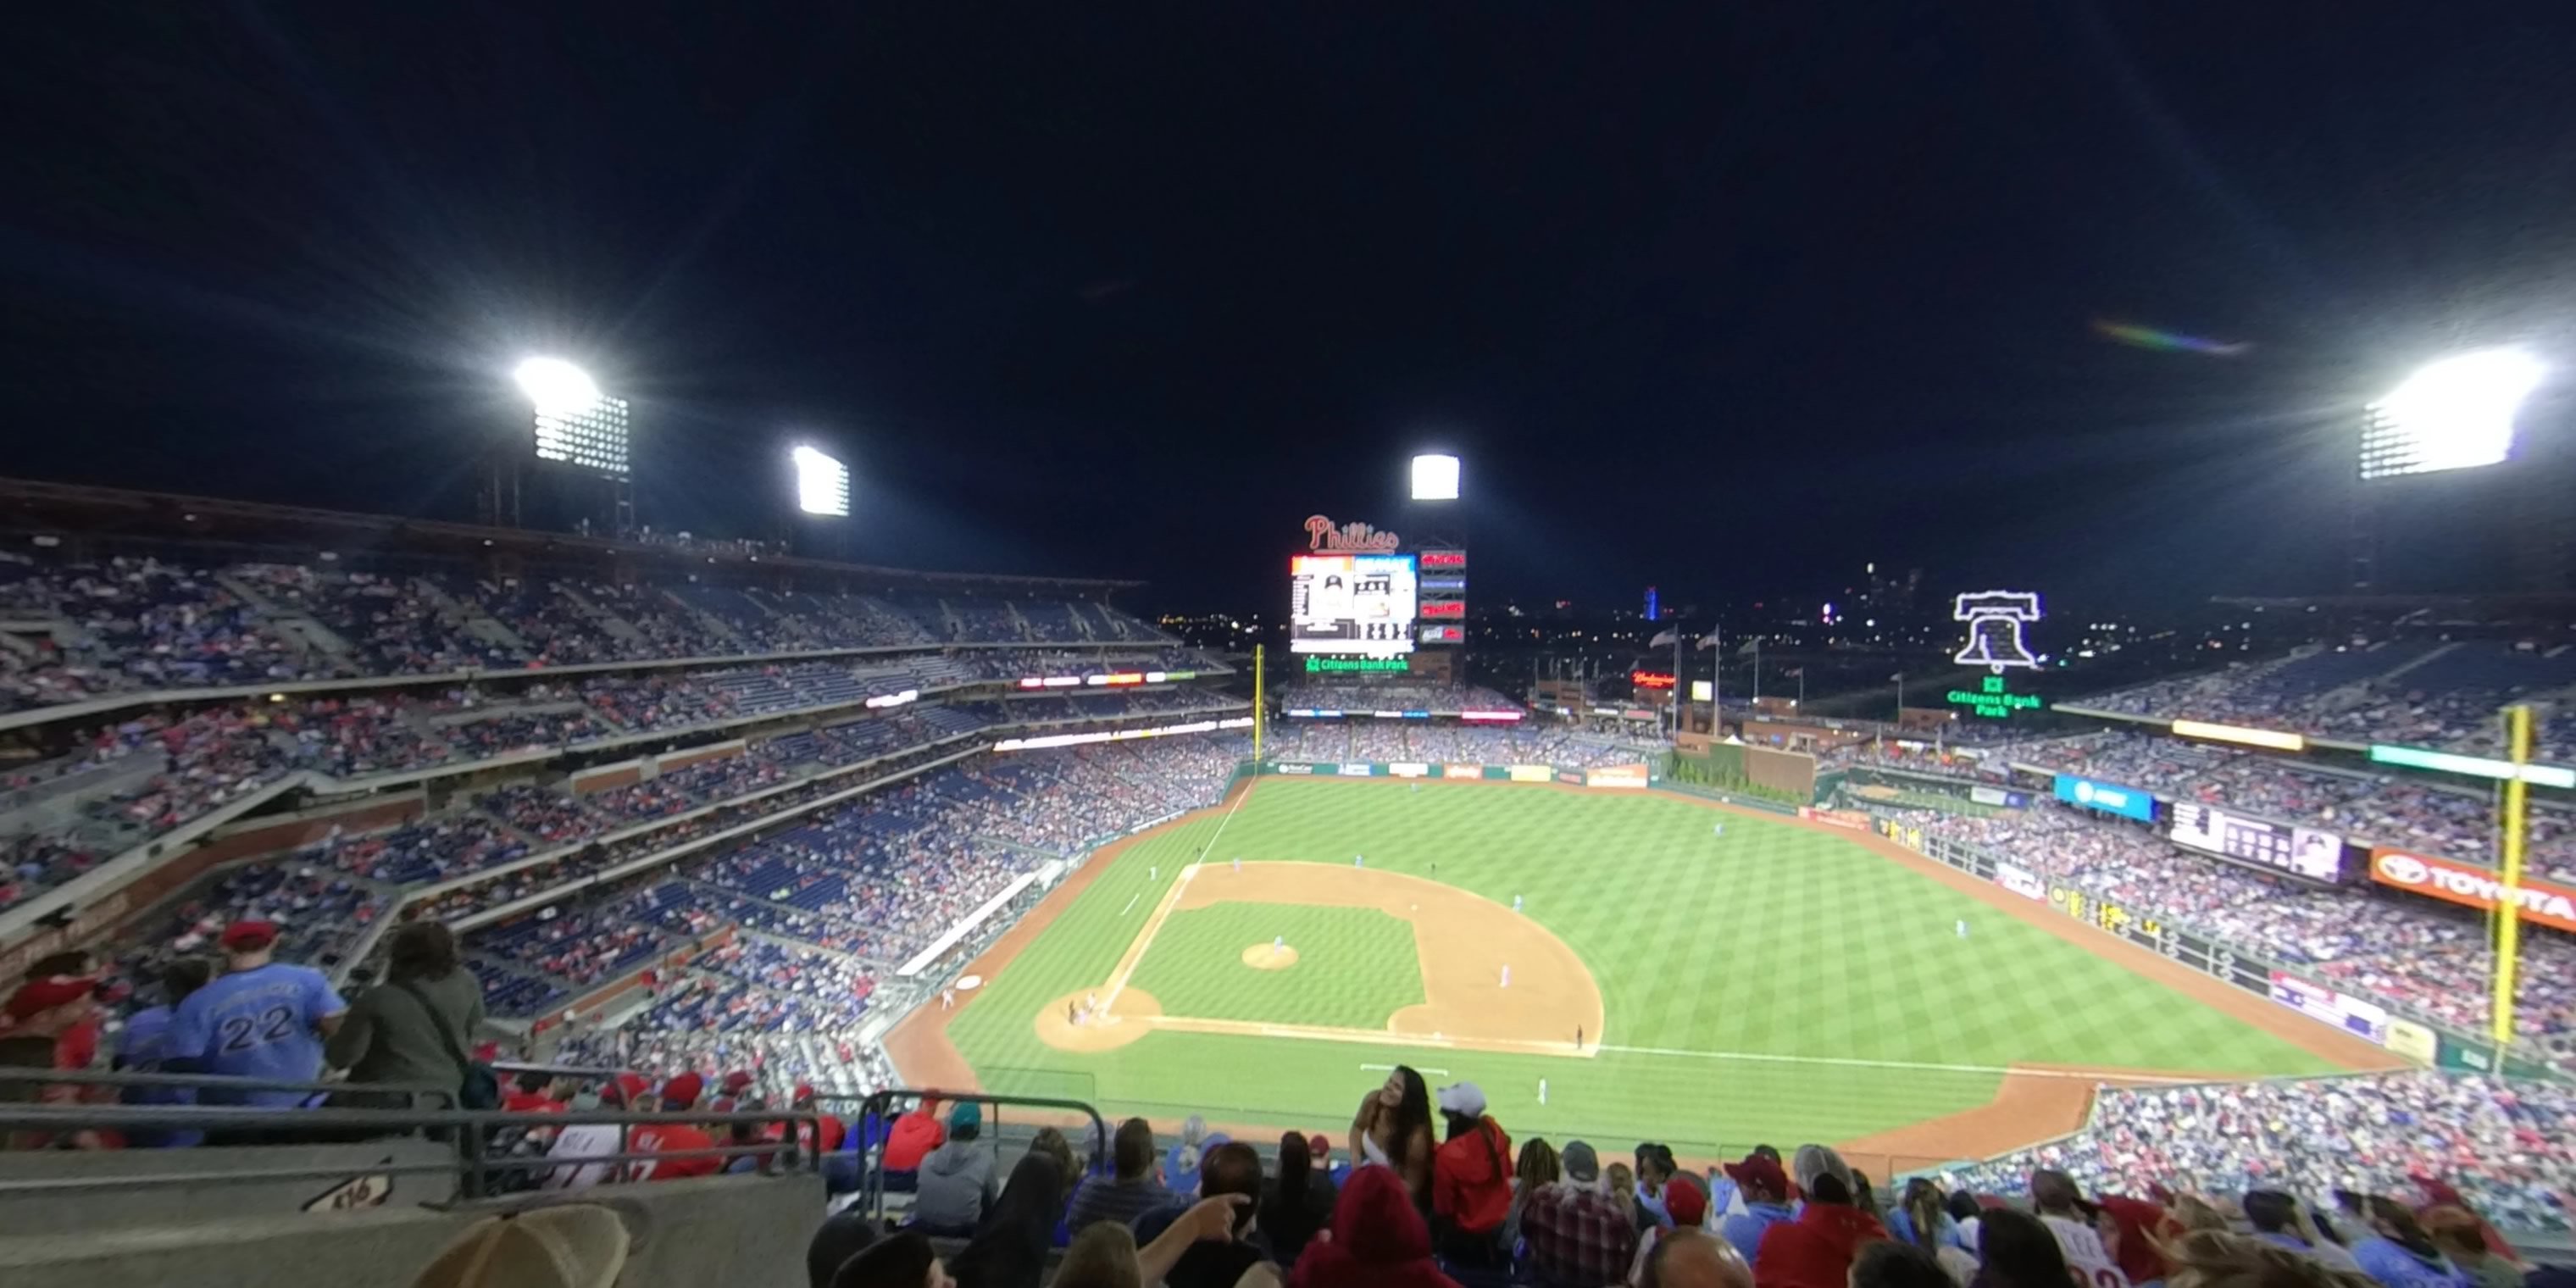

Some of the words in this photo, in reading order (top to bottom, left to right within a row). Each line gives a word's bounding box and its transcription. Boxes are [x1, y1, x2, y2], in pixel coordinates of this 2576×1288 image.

[1305, 514, 1399, 550] Phillies
[1321, 659, 1359, 670] Citizens
[1360, 658, 1385, 670] Bank
[1385, 658, 1408, 670] Park
[1947, 691, 2001, 705] Citizens
[2003, 694, 2040, 709] Bank
[1976, 705, 2008, 718] Park
[221, 1005, 293, 1053] 22
